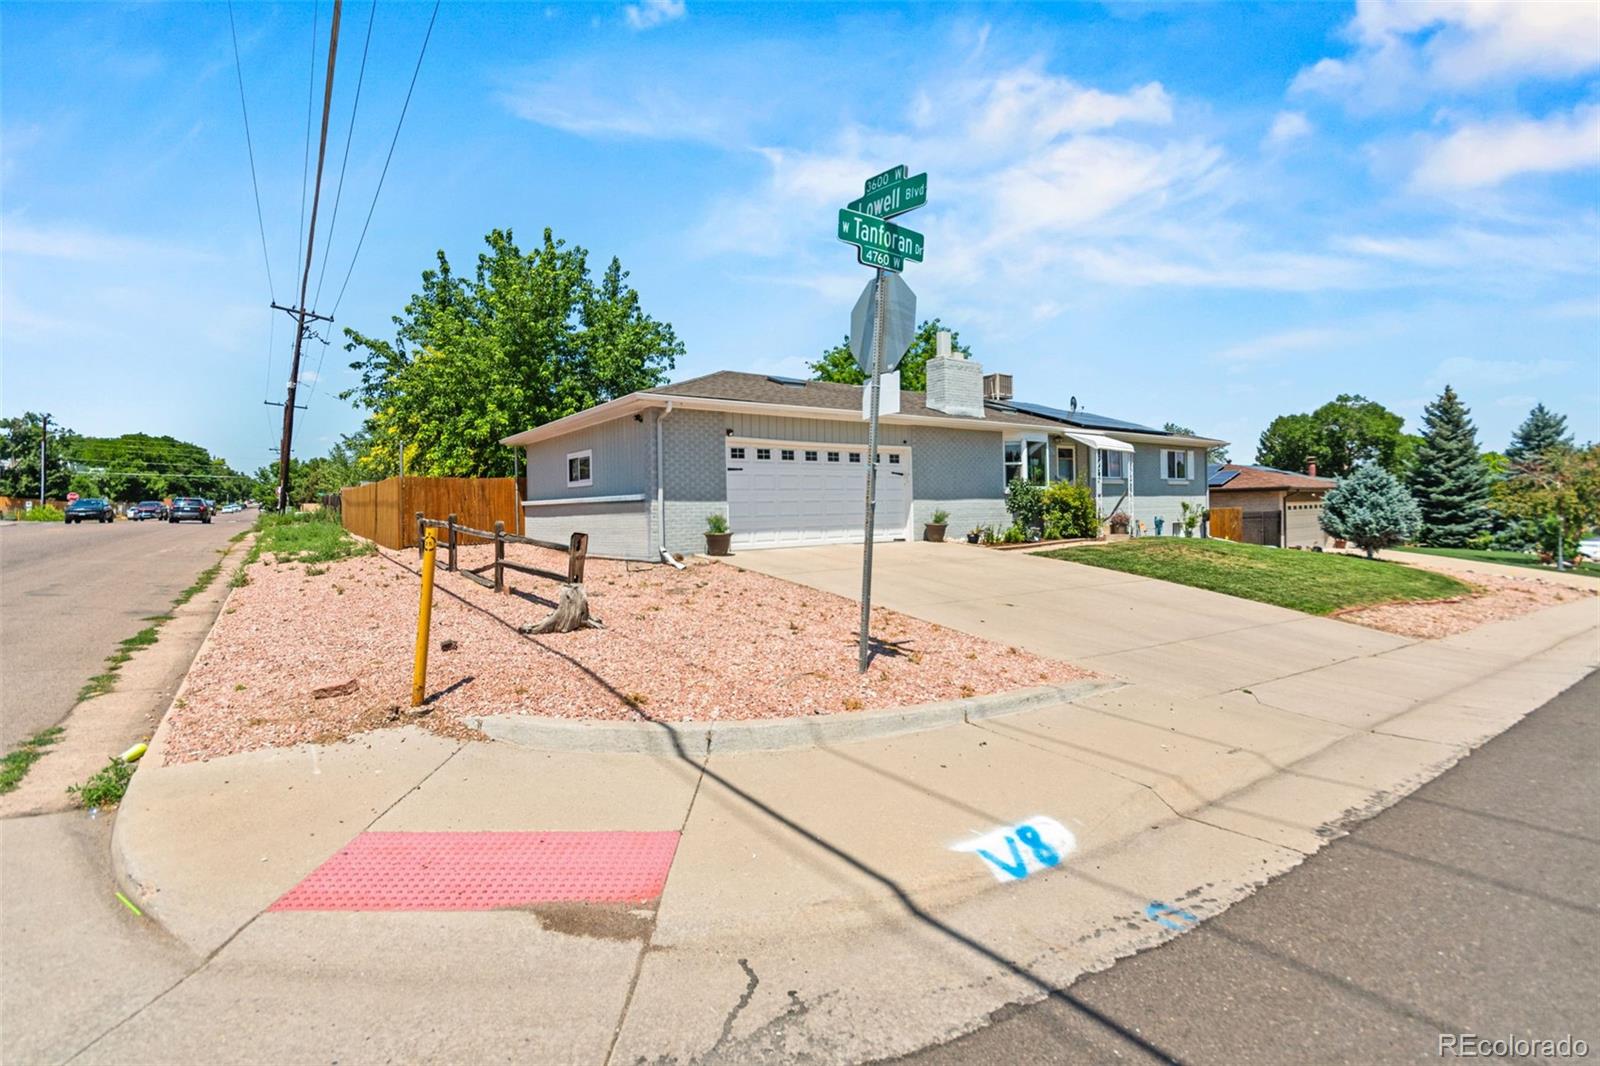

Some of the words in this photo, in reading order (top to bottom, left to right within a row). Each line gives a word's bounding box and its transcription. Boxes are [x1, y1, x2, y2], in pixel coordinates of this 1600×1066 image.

[866, 173, 889, 193] 3600
[895, 167, 903, 181] W
[905, 183, 925, 200] Blvd
[842, 221, 850, 234] W
[854, 217, 913, 255] Tanforan
[915, 243, 924, 256] Dr
[866, 250, 890, 266] 4760
[893, 256, 900, 269] W
[976, 825, 1061, 880] V8
